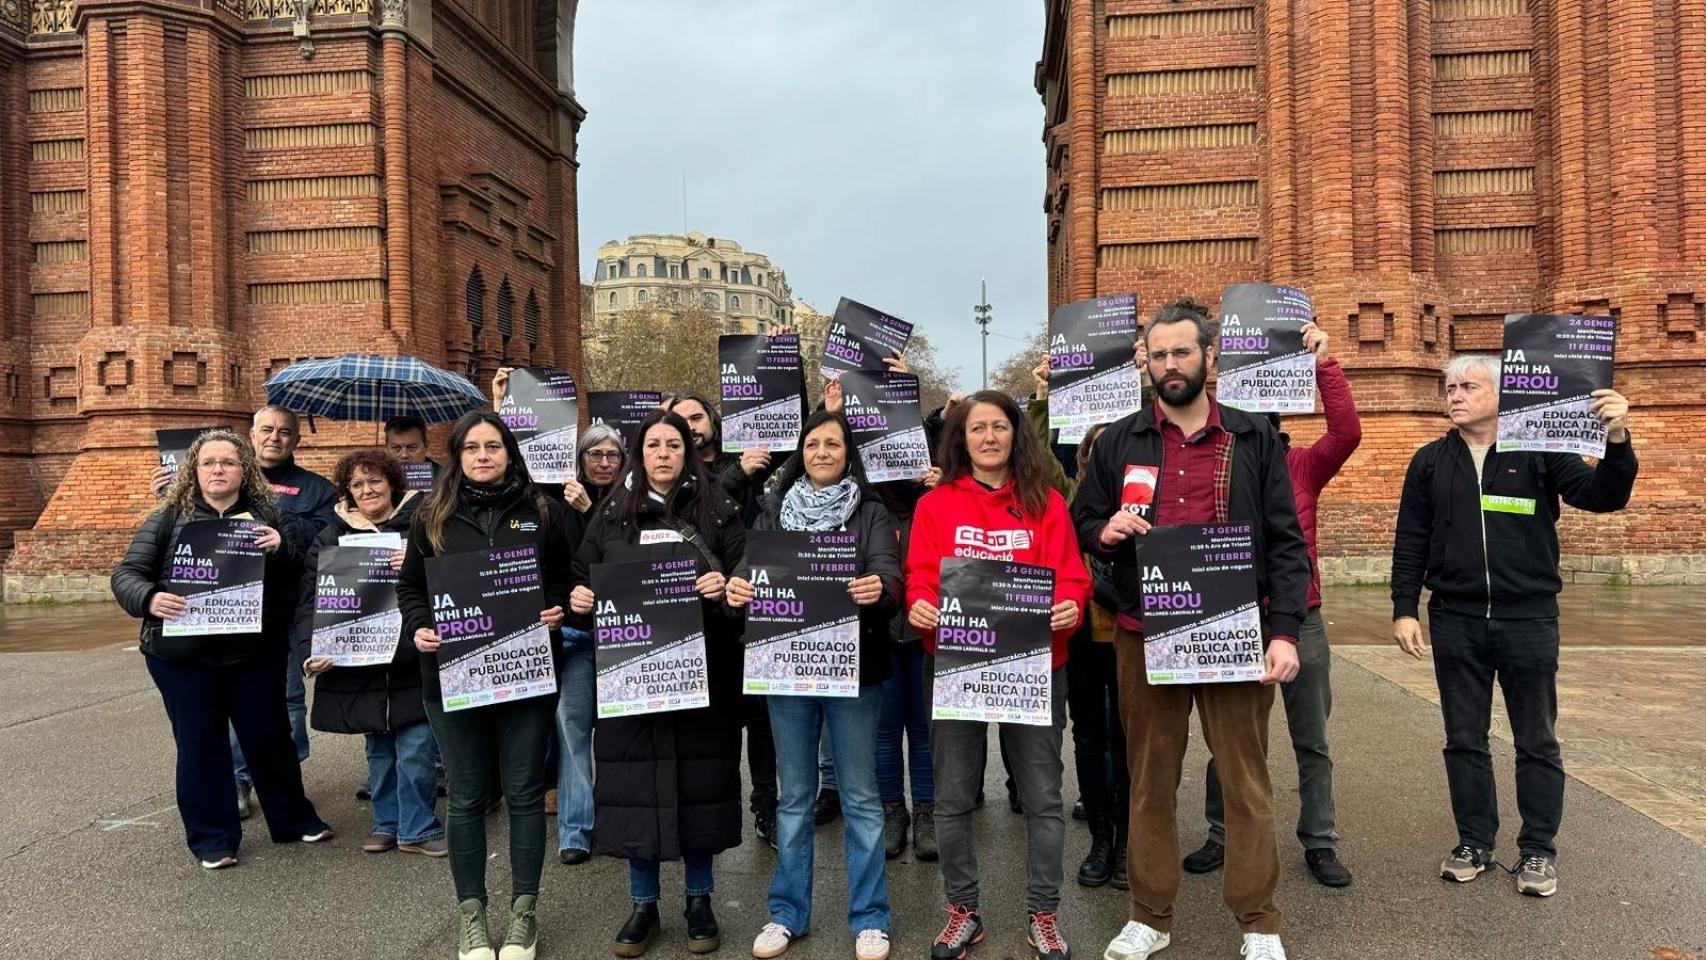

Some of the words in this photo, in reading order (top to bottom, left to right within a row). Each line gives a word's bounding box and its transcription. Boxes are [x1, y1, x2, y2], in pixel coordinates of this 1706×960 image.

[1222, 314, 1241, 326] JA
[1583, 320, 1613, 328] GENER
[831, 322, 846, 337] JA
[1246, 327, 1263, 336] HA
[848, 340, 860, 350] HA
[1050, 333, 1066, 346] JA
[1221, 337, 1269, 350] PROU
[826, 342, 864, 362] PROU
[1072, 343, 1087, 353] HA
[1579, 343, 1612, 352] FEBRER
[1050, 352, 1094, 368] PROU
[1504, 349, 1526, 362] JA
[721, 363, 738, 375] JA
[1256, 368, 1313, 378] EDUCACIÓ
[1504, 364, 1529, 374] N'HI
[1532, 365, 1551, 374] HA
[743, 375, 757, 384] HA
[1298, 379, 1312, 387] DE
[1503, 375, 1559, 389] PROU
[722, 384, 763, 396] PROU
[1260, 389, 1312, 398] QUALITAT
[844, 394, 861, 406] JA
[866, 406, 880, 415] HA
[847, 415, 887, 427] PROU
[1591, 421, 1606, 431] DE
[758, 430, 799, 438] QUALITAT
[1546, 430, 1605, 441] QUALITAT
[162, 454, 176, 465] JA
[1121, 503, 1150, 516] CGT
[1202, 527, 1214, 535] 24
[1217, 525, 1250, 534] GENER
[810, 535, 821, 544] 24
[823, 535, 855, 544] GENER
[175, 544, 192, 556] JA
[489, 553, 502, 561] 24
[503, 548, 535, 559] GENER
[954, 546, 1014, 562] educació
[197, 558, 213, 567] HA
[1204, 554, 1212, 562] 11
[1215, 552, 1252, 561] FEBRER
[652, 563, 663, 571] 24
[665, 560, 695, 570] GENER
[810, 563, 818, 571] 11
[820, 563, 856, 572] FEBRER
[1005, 565, 1018, 574] 24
[1020, 566, 1052, 577] GENER
[172, 566, 219, 580] PROU
[750, 569, 770, 585] JA
[1141, 565, 1164, 581] JA
[318, 574, 336, 586] JA
[493, 578, 502, 587] 11
[503, 573, 538, 585] FEBRER
[340, 588, 356, 596] HA
[655, 588, 662, 596] 11
[777, 588, 796, 599] HA
[1142, 583, 1169, 594] N'HI
[1172, 581, 1192, 592] HA
[317, 597, 362, 609] PROU
[433, 593, 455, 610] JA
[940, 597, 962, 613] JA
[1005, 593, 1013, 601] 11
[1015, 593, 1051, 604] FEBRER
[1144, 592, 1201, 610] PROU
[434, 609, 461, 622] N'HI
[463, 606, 483, 618] HA
[595, 600, 617, 615] JA
[749, 600, 804, 616] PROU
[208, 616, 258, 624] QUALITAT
[597, 615, 621, 627] N'HI
[624, 613, 643, 625] HA
[940, 615, 965, 627] N'HI
[969, 616, 988, 628] HA
[436, 616, 493, 639] PROU
[597, 624, 651, 643] PROU
[1191, 626, 1258, 642] EDUCACIÓ
[939, 627, 996, 646] PROU
[791, 639, 856, 653] EDUCACIÓ
[1174, 640, 1231, 654] PÚBLICA
[1234, 642, 1238, 651] I
[1242, 640, 1259, 650] DE
[484, 644, 548, 663] EDUCACIÓ
[774, 650, 828, 664] PÚBLICA
[831, 654, 835, 664] I
[840, 654, 856, 664] DE
[1198, 653, 1260, 665] QUALITAT
[469, 658, 524, 677] PÚBLICA
[533, 656, 550, 667] DE
[641, 656, 703, 672] EDUCACIÓ
[492, 667, 551, 686] QUALITAT
[626, 670, 679, 686] PÚBLICA
[689, 670, 704, 679] DE
[795, 666, 856, 677] QUALITAT
[980, 671, 1048, 685] EDUCACIÓ
[646, 681, 704, 694] QUALITAT
[963, 681, 1019, 696] PÚBLICA
[1030, 687, 1048, 698] DE
[985, 696, 1048, 710] QUALITAT
